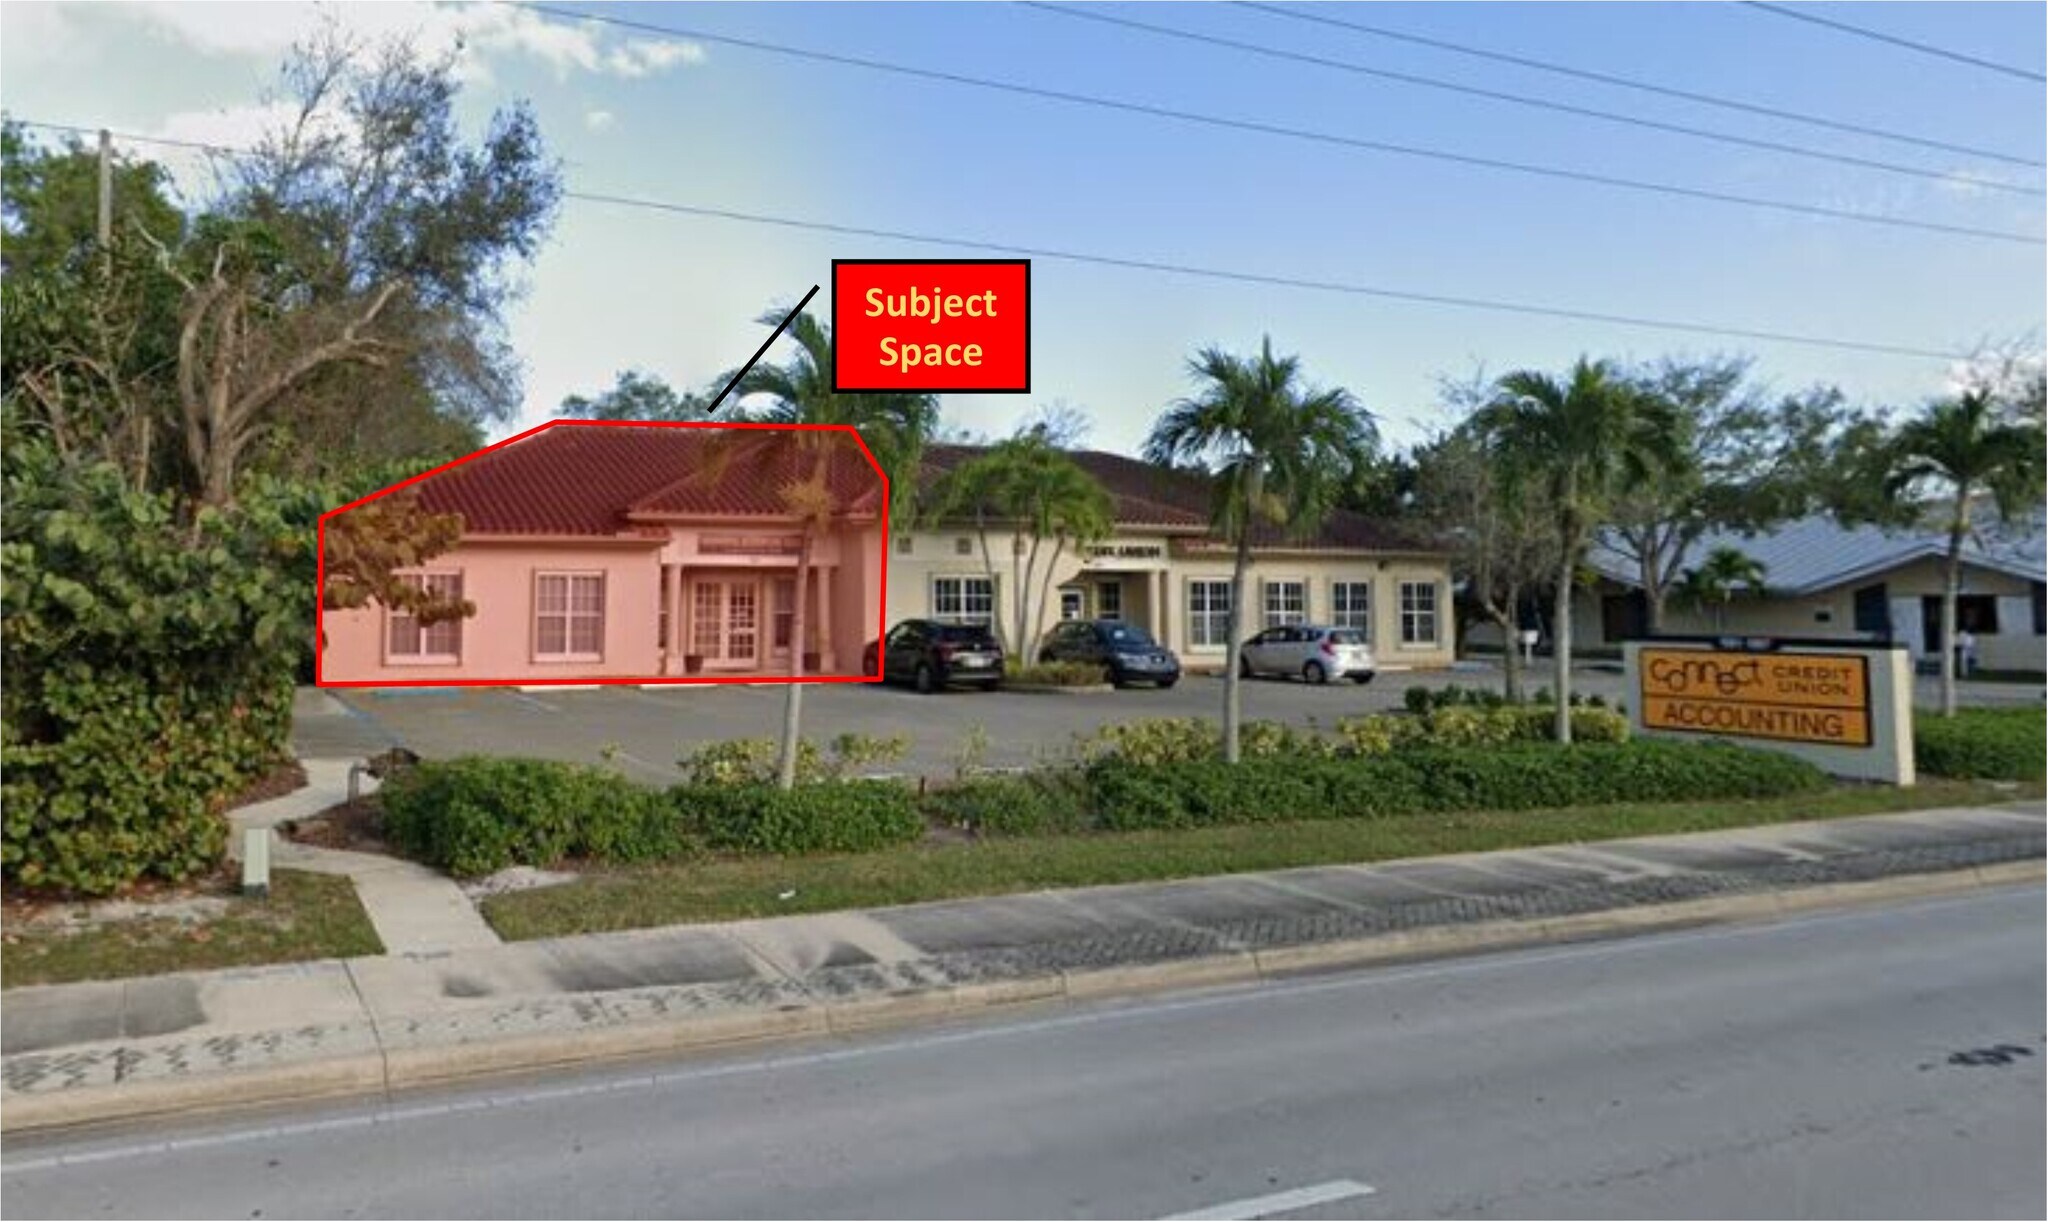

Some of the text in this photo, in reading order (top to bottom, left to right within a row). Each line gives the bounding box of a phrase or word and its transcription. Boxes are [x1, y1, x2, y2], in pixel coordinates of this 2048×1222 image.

[1772, 666, 1853, 682] CREDIT
[1776, 680, 1849, 696] UNION
[1664, 703, 1843, 737] ACCOUNTING
